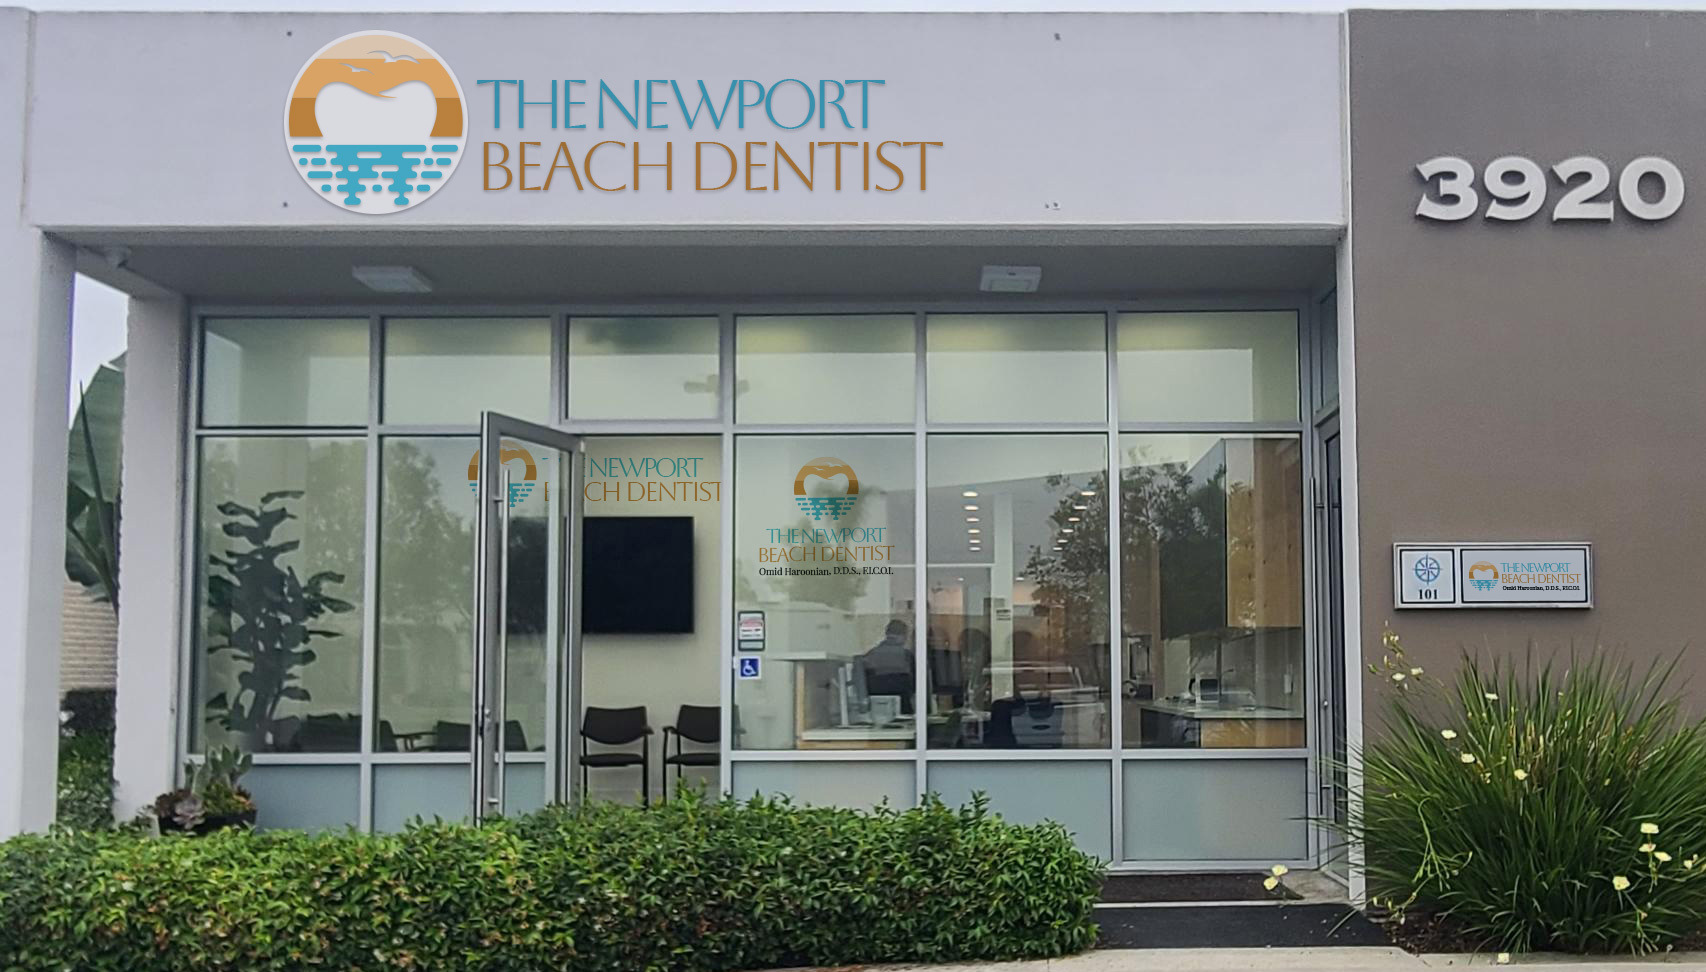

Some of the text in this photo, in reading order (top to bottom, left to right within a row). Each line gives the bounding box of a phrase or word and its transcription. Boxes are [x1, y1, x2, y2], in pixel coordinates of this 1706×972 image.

[477, 78, 886, 130] THE NEWPORT
[482, 140, 944, 192] BEACH DENTIST
[1415, 155, 1686, 221] 3920
[590, 457, 704, 478] NEWPORT
[628, 481, 721, 502] DENTIST
[766, 527, 887, 543] THE NEWPORT
[759, 545, 896, 562] BEACH DENTIST
[759, 567, 783, 576] Omid
[1500, 562, 1571, 573] THE NEWPORT
[1501, 573, 1582, 584] BEACH DENTIST
[1418, 589, 1438, 600] 101
